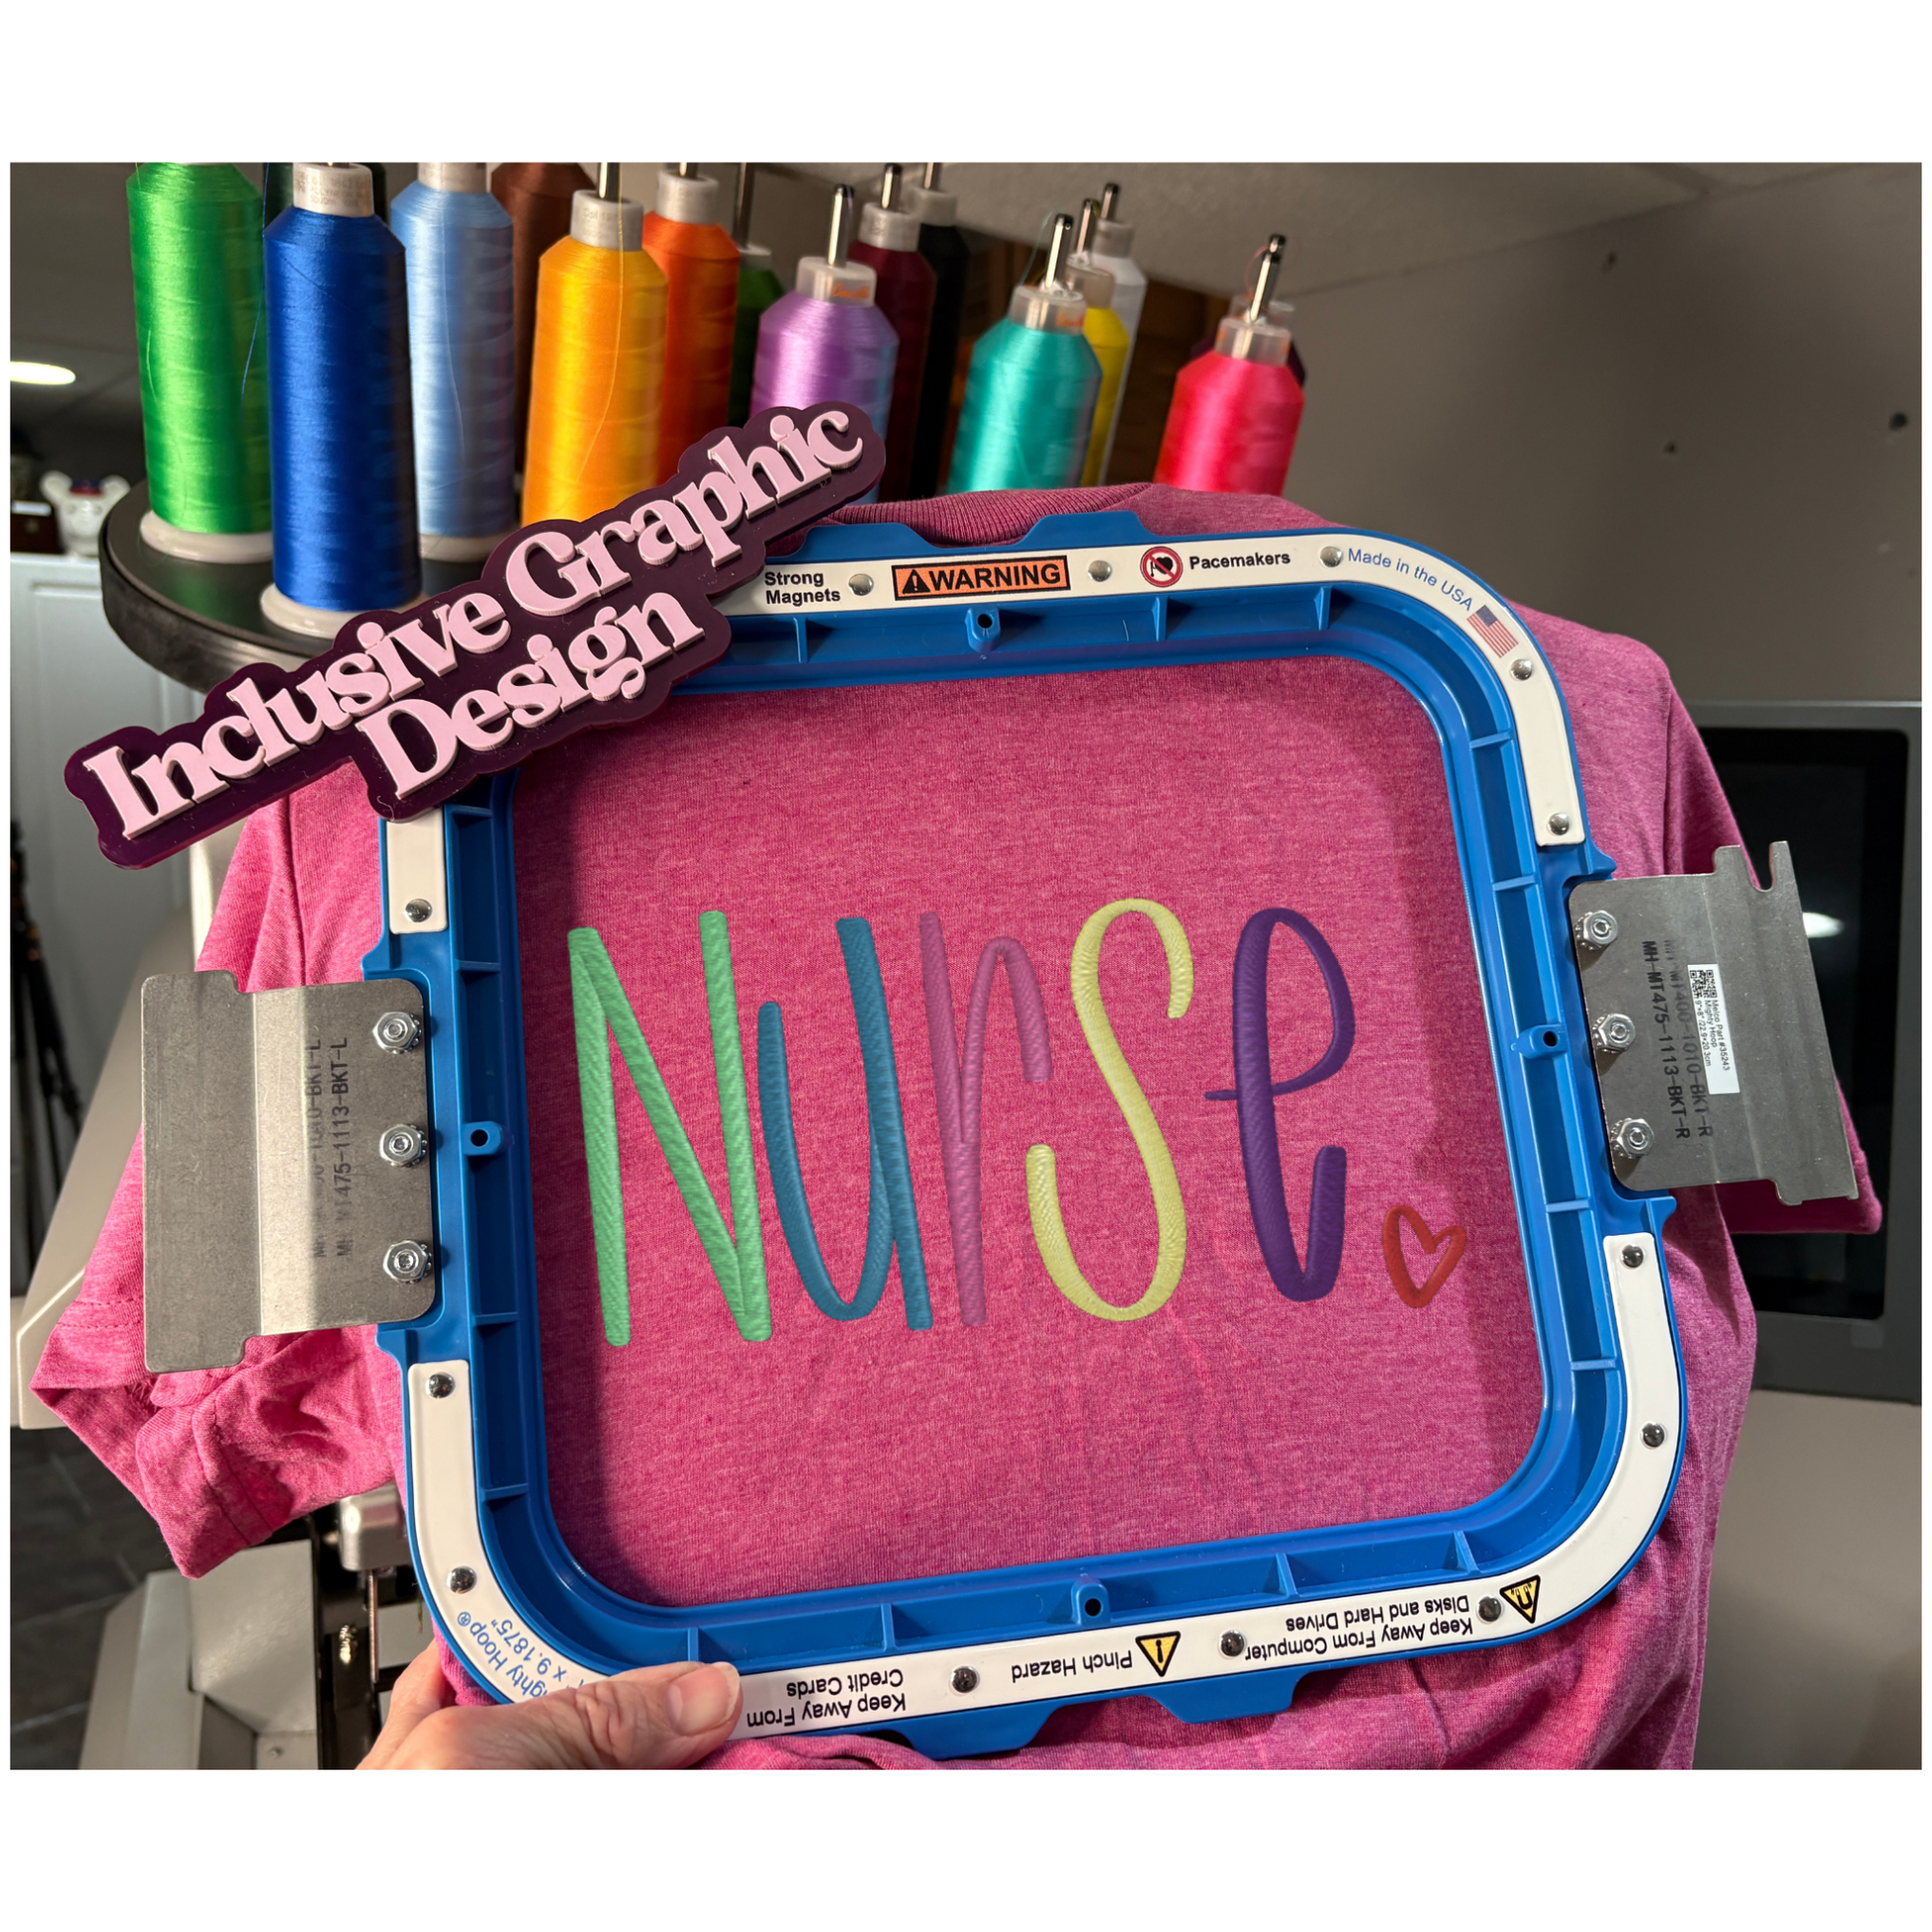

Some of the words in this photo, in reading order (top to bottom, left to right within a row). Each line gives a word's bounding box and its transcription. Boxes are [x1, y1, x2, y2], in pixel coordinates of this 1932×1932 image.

[1188, 550, 1292, 570] Pacemakers
[764, 569, 824, 589] Strong
[928, 563, 1062, 591] WARNING
[1348, 548, 1392, 568] Made
[1396, 558, 1410, 574] in
[1414, 566, 1438, 587] the
[1441, 580, 1473, 612] USA
[764, 586, 841, 605] Magnets
[1704, 1000, 1714, 1026] Mighty
[1642, 940, 1691, 1139] MH-MT475-1113-BKT-R
[1716, 1024, 1725, 1040] Part
[1719, 1041, 1729, 1071] #35243
[567, 897, 1356, 1347] Nurse
[1389, 1600, 1420, 1619] and
[1425, 1594, 1469, 1614] Disks
[1286, 1612, 1338, 1631] Drives
[1344, 1606, 1384, 1625] Hard
[1430, 1617, 1473, 1635] Keep
[1332, 1630, 1376, 1648] From
[1381, 1623, 1426, 1643] Away
[1082, 1649, 1133, 1672] Pinch
[1245, 1637, 1327, 1662] Computer
[506, 1664, 548, 1698] ghty
[848, 1668, 903, 1693] Credit
[1011, 1656, 1076, 1684] Hazard
[786, 1676, 842, 1699] Cards
[801, 1699, 853, 1722] Away
[859, 1693, 905, 1713] Keep
[747, 1706, 795, 1727] From
